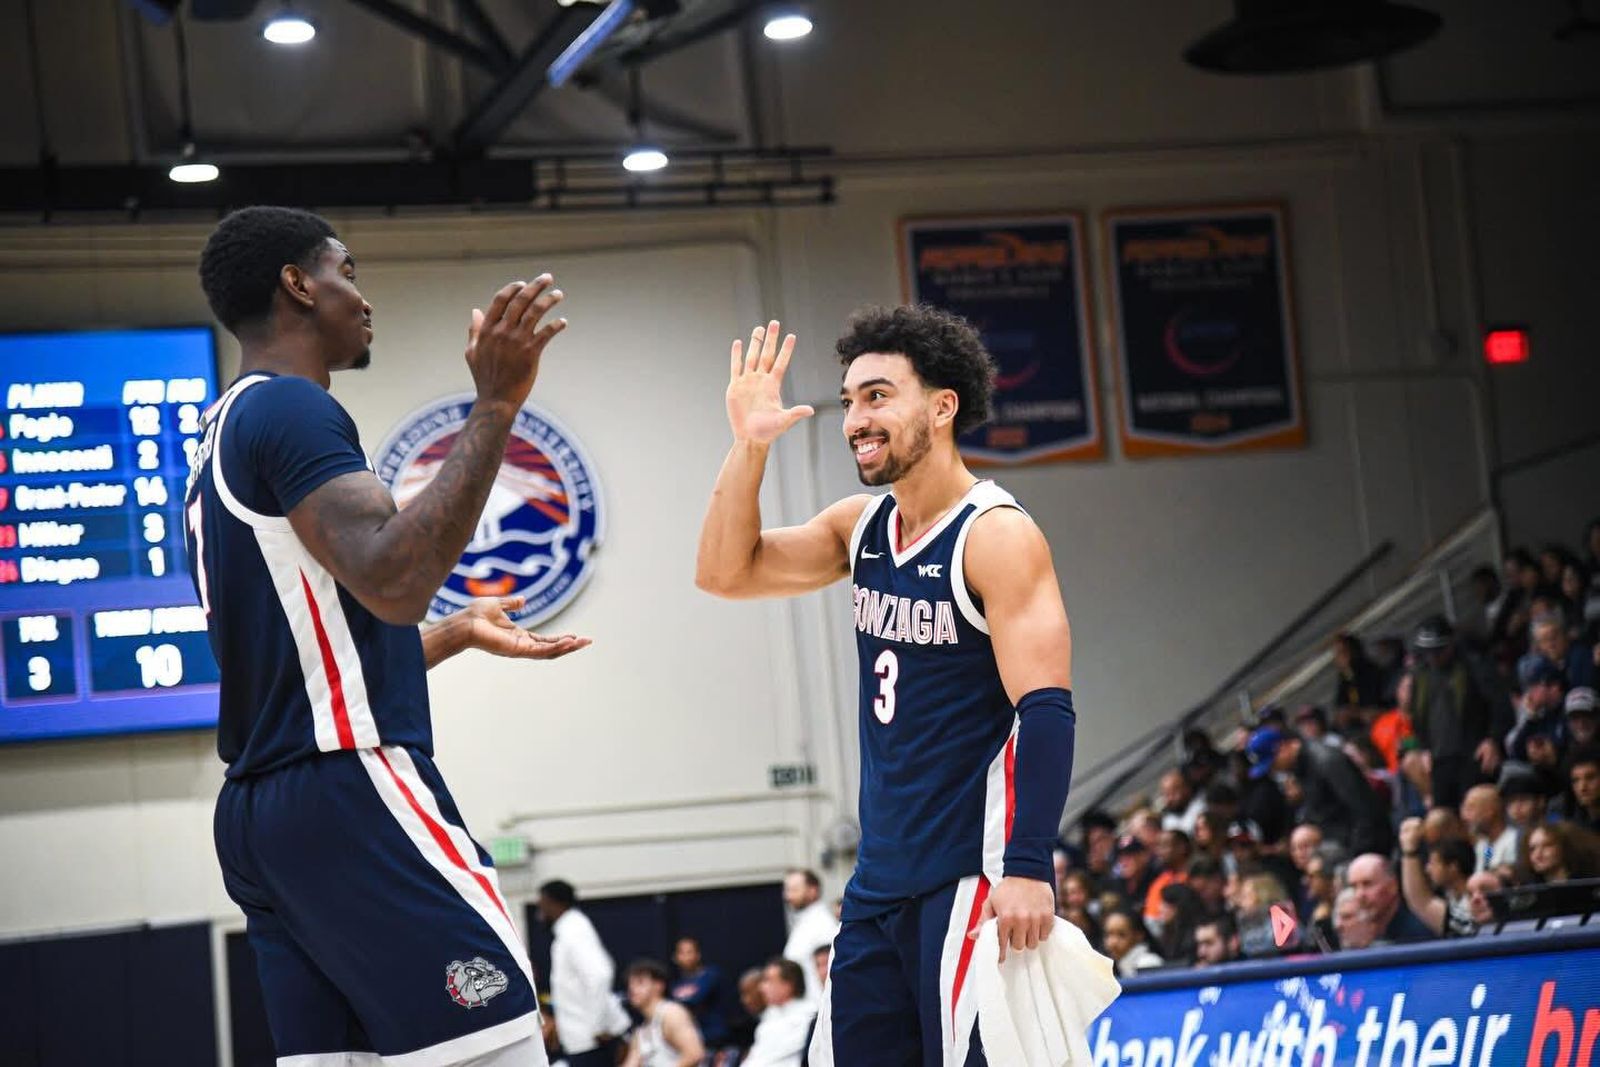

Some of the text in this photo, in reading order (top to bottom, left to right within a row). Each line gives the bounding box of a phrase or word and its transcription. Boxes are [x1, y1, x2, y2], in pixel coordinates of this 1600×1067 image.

[148, 547, 165, 577] 1
[917, 564, 943, 578] WCC
[28, 644, 183, 691] 3 10
[873, 649, 899, 725] 3
[1355, 984, 1512, 1067] their
